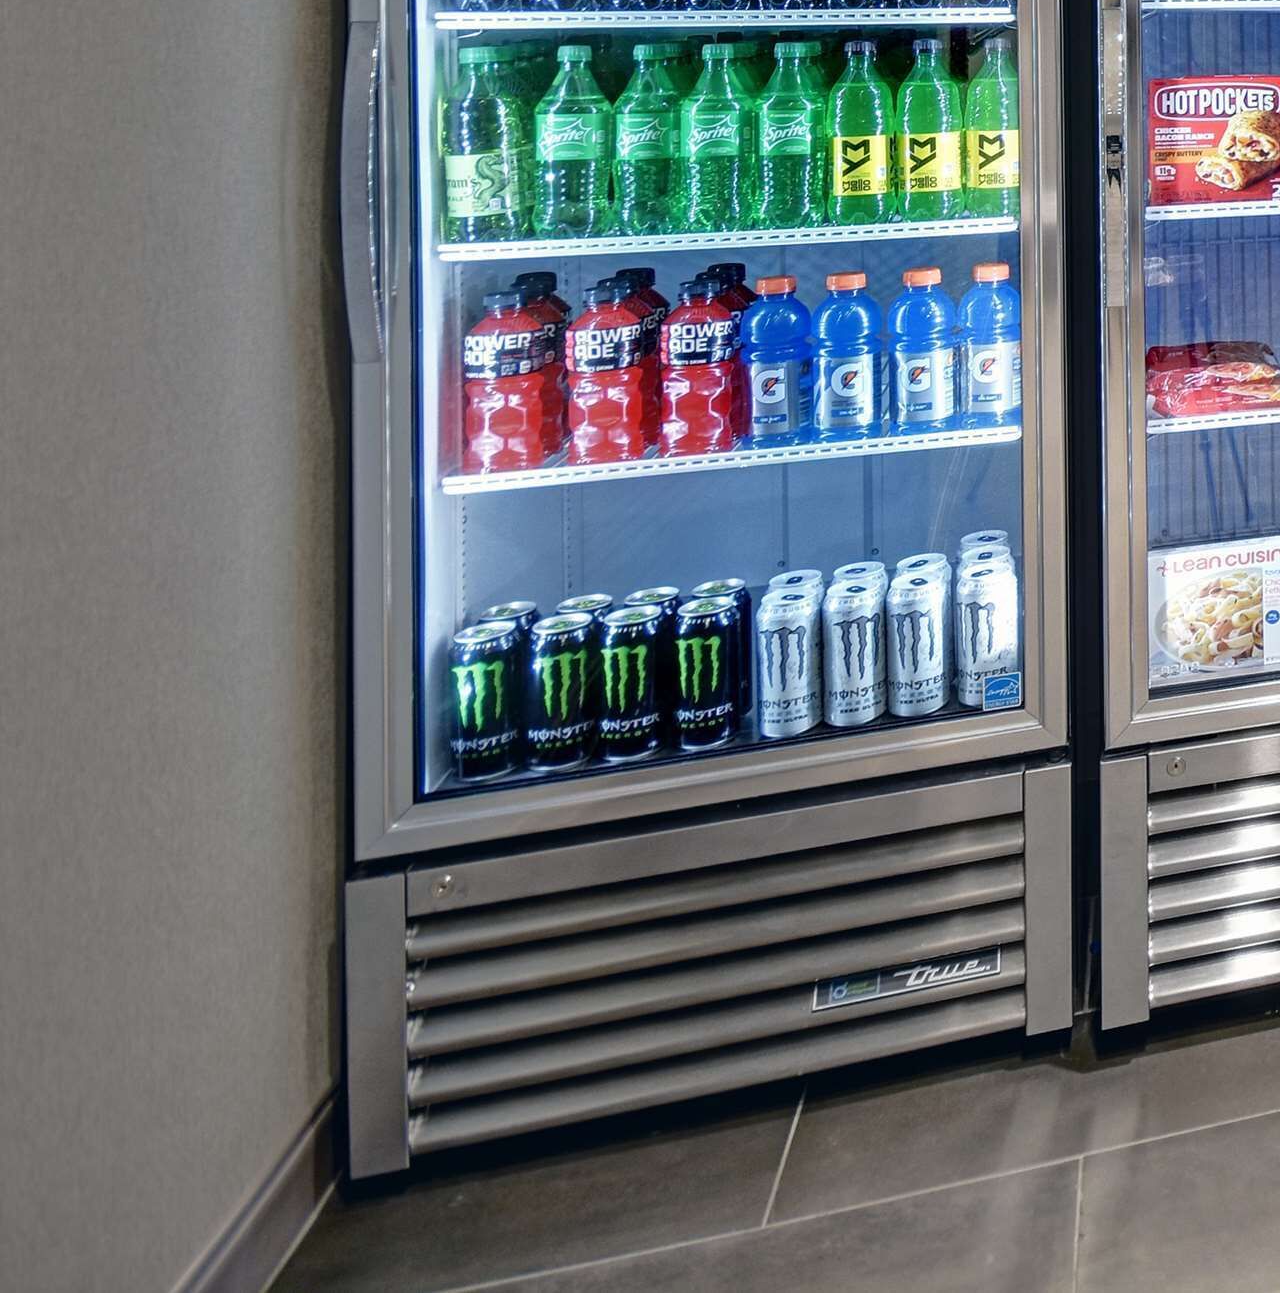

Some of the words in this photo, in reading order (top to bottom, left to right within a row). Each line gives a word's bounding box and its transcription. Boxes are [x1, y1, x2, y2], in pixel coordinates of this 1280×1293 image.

[1161, 88, 1199, 116] HOT
[1198, 87, 1276, 116] POCKETS
[621, 128, 662, 144] Sprite
[691, 125, 733, 143] Sprite
[767, 124, 808, 143] Sprite
[574, 324, 641, 345] POWER
[669, 320, 733, 339] POWER
[897, 357, 933, 393] G
[971, 349, 1003, 384] G
[753, 367, 786, 404] G
[830, 362, 865, 397] G
[960, 666, 1008, 682] ONSTER
[600, 712, 660, 733] ONSTER
[676, 702, 734, 722] ONSTER
